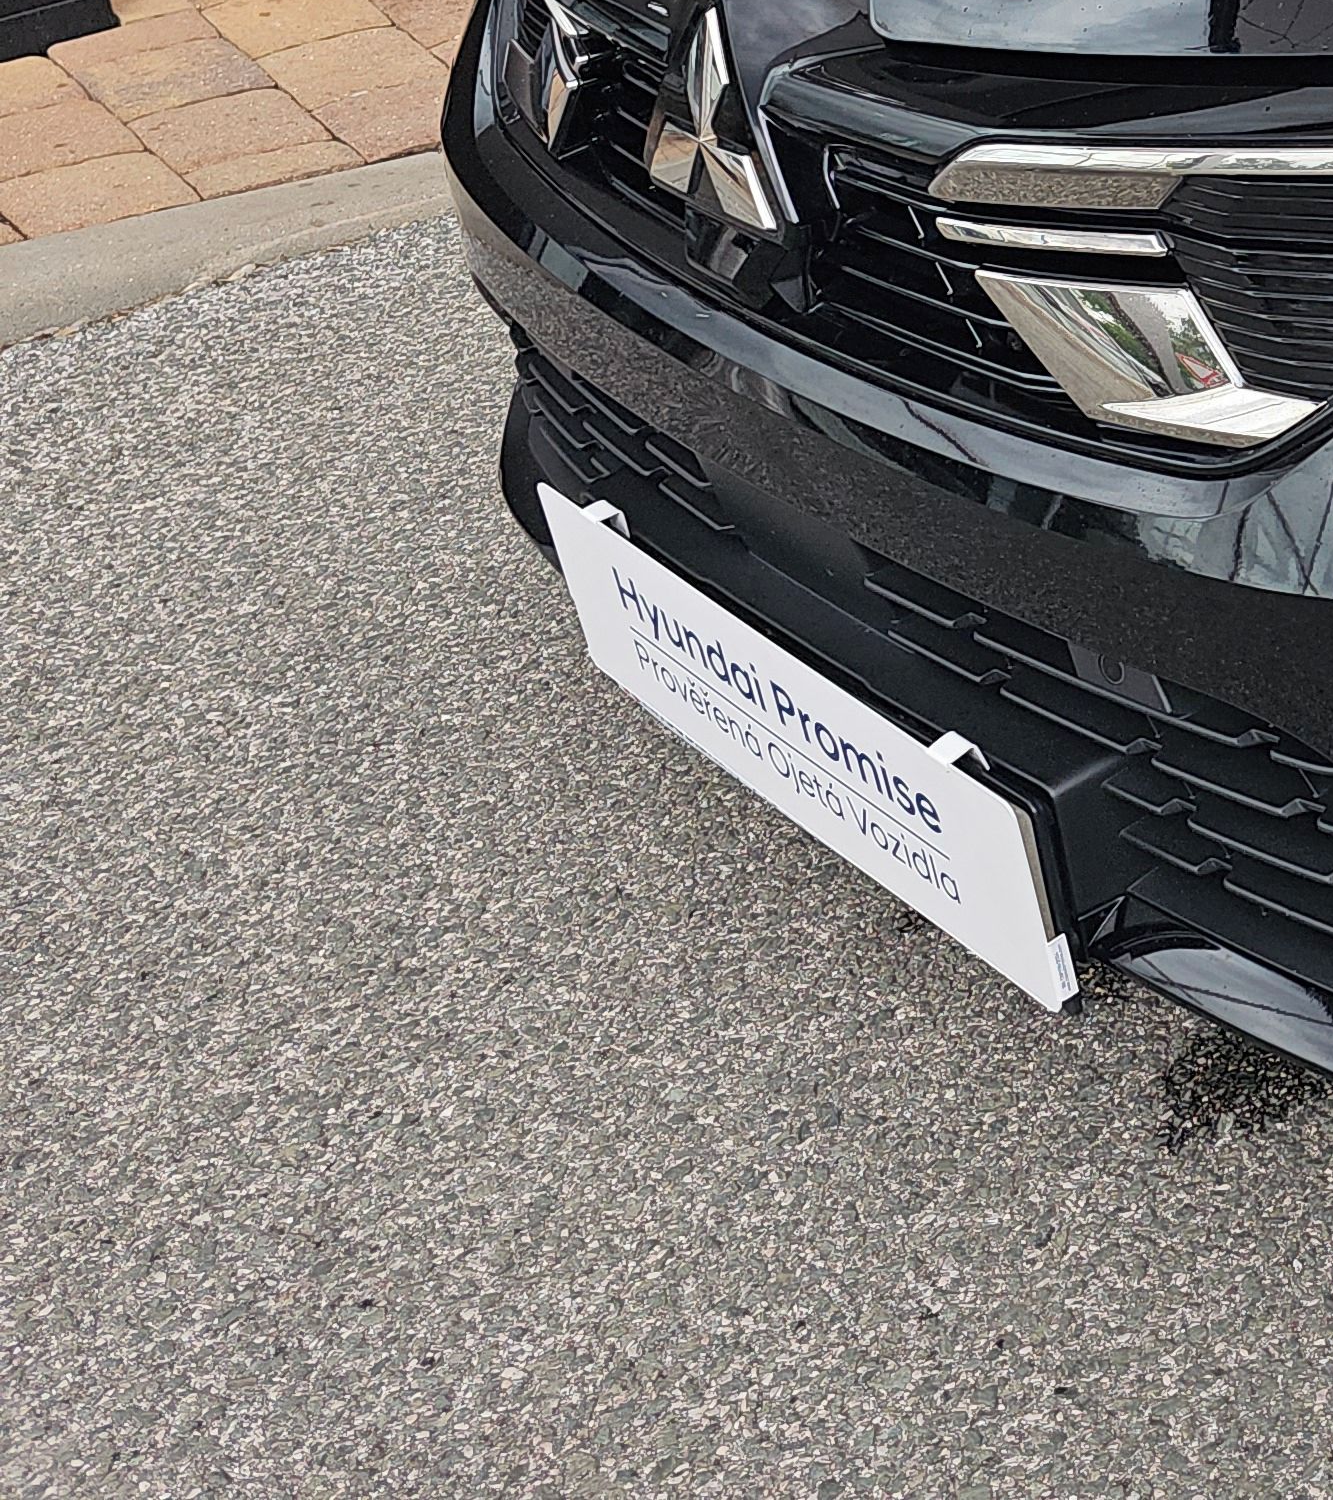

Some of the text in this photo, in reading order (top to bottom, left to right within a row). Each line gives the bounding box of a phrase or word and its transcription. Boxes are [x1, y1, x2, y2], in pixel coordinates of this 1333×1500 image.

[612, 566, 942, 834] Hyundai Promise
[634, 638, 961, 905] Prověřená Ojetá Vozidla
